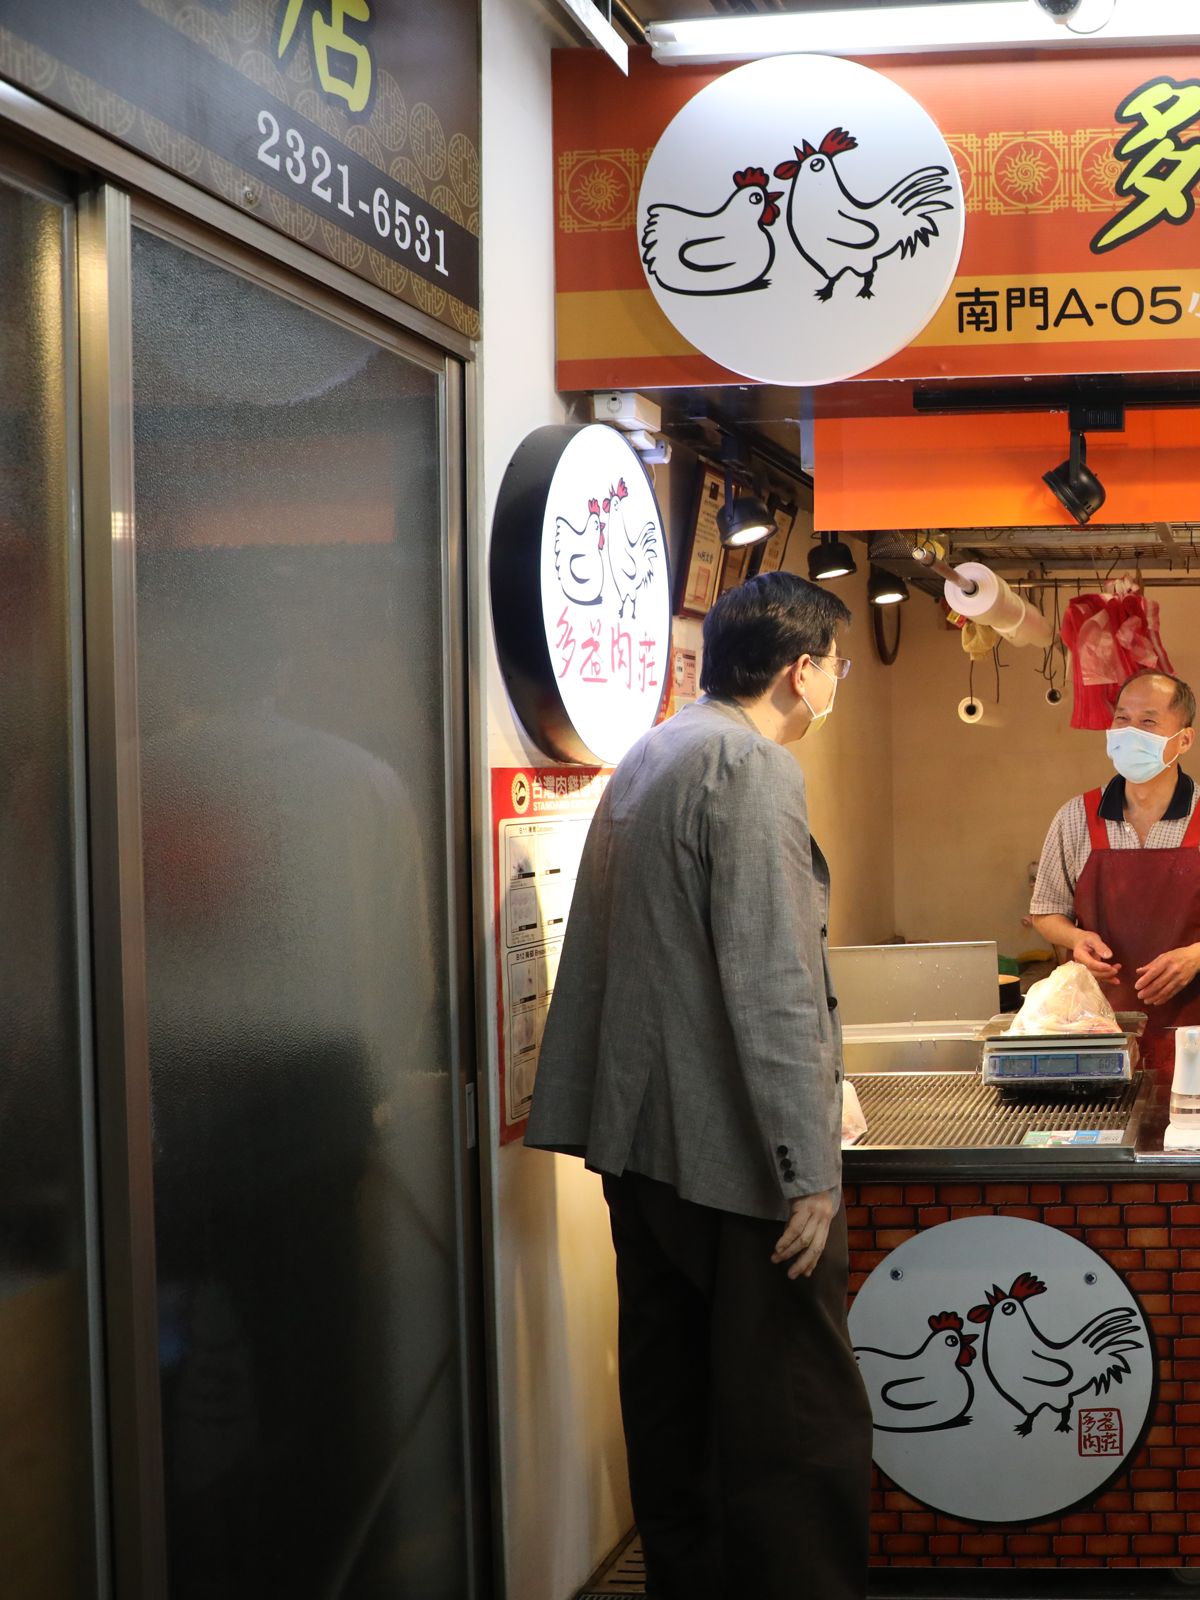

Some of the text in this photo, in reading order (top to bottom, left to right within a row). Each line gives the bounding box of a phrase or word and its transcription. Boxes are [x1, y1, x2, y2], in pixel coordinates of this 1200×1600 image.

[257, 110, 450, 277] 2321-6531
[955, 285, 1183, 333] 南門A-05
[556, 606, 658, 693] 多益肉莊
